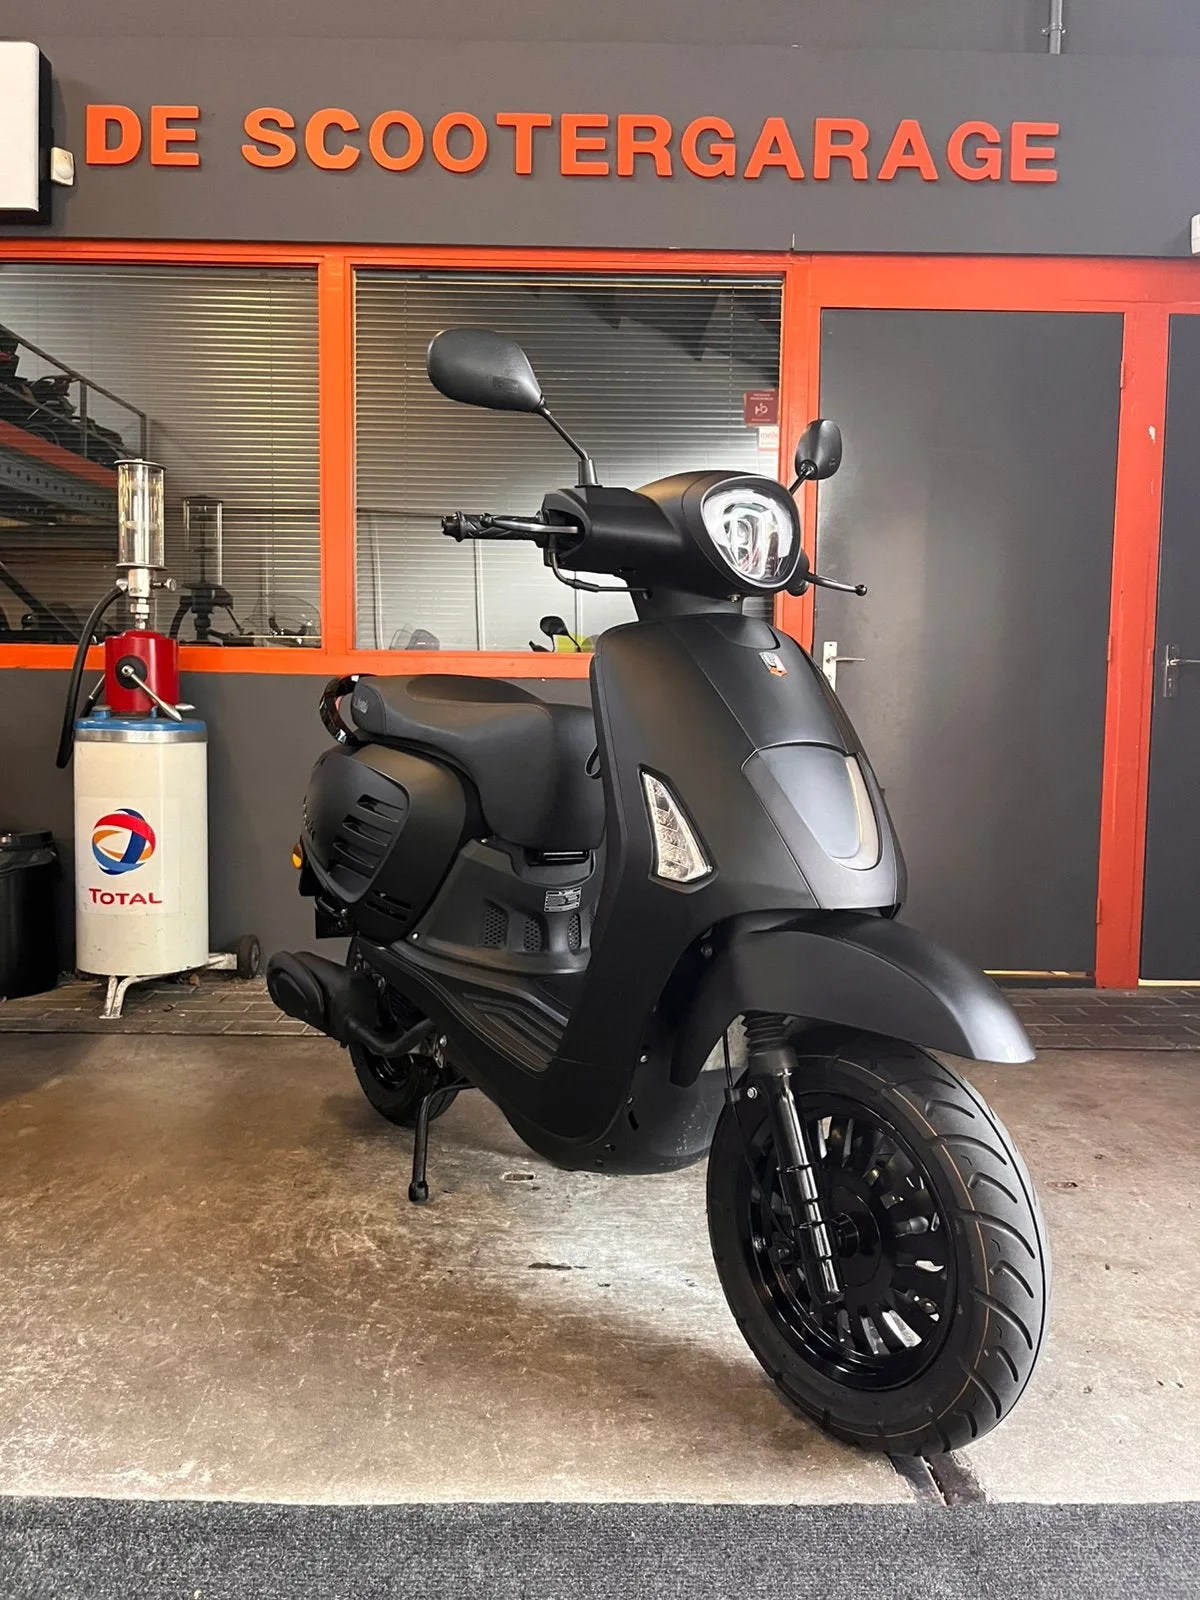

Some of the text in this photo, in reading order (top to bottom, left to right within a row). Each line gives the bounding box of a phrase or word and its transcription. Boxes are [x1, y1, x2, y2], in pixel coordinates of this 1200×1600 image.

[85, 104, 1060, 184] DE SCOOTERGARAGE
[89, 888, 162, 905] TOTAL
